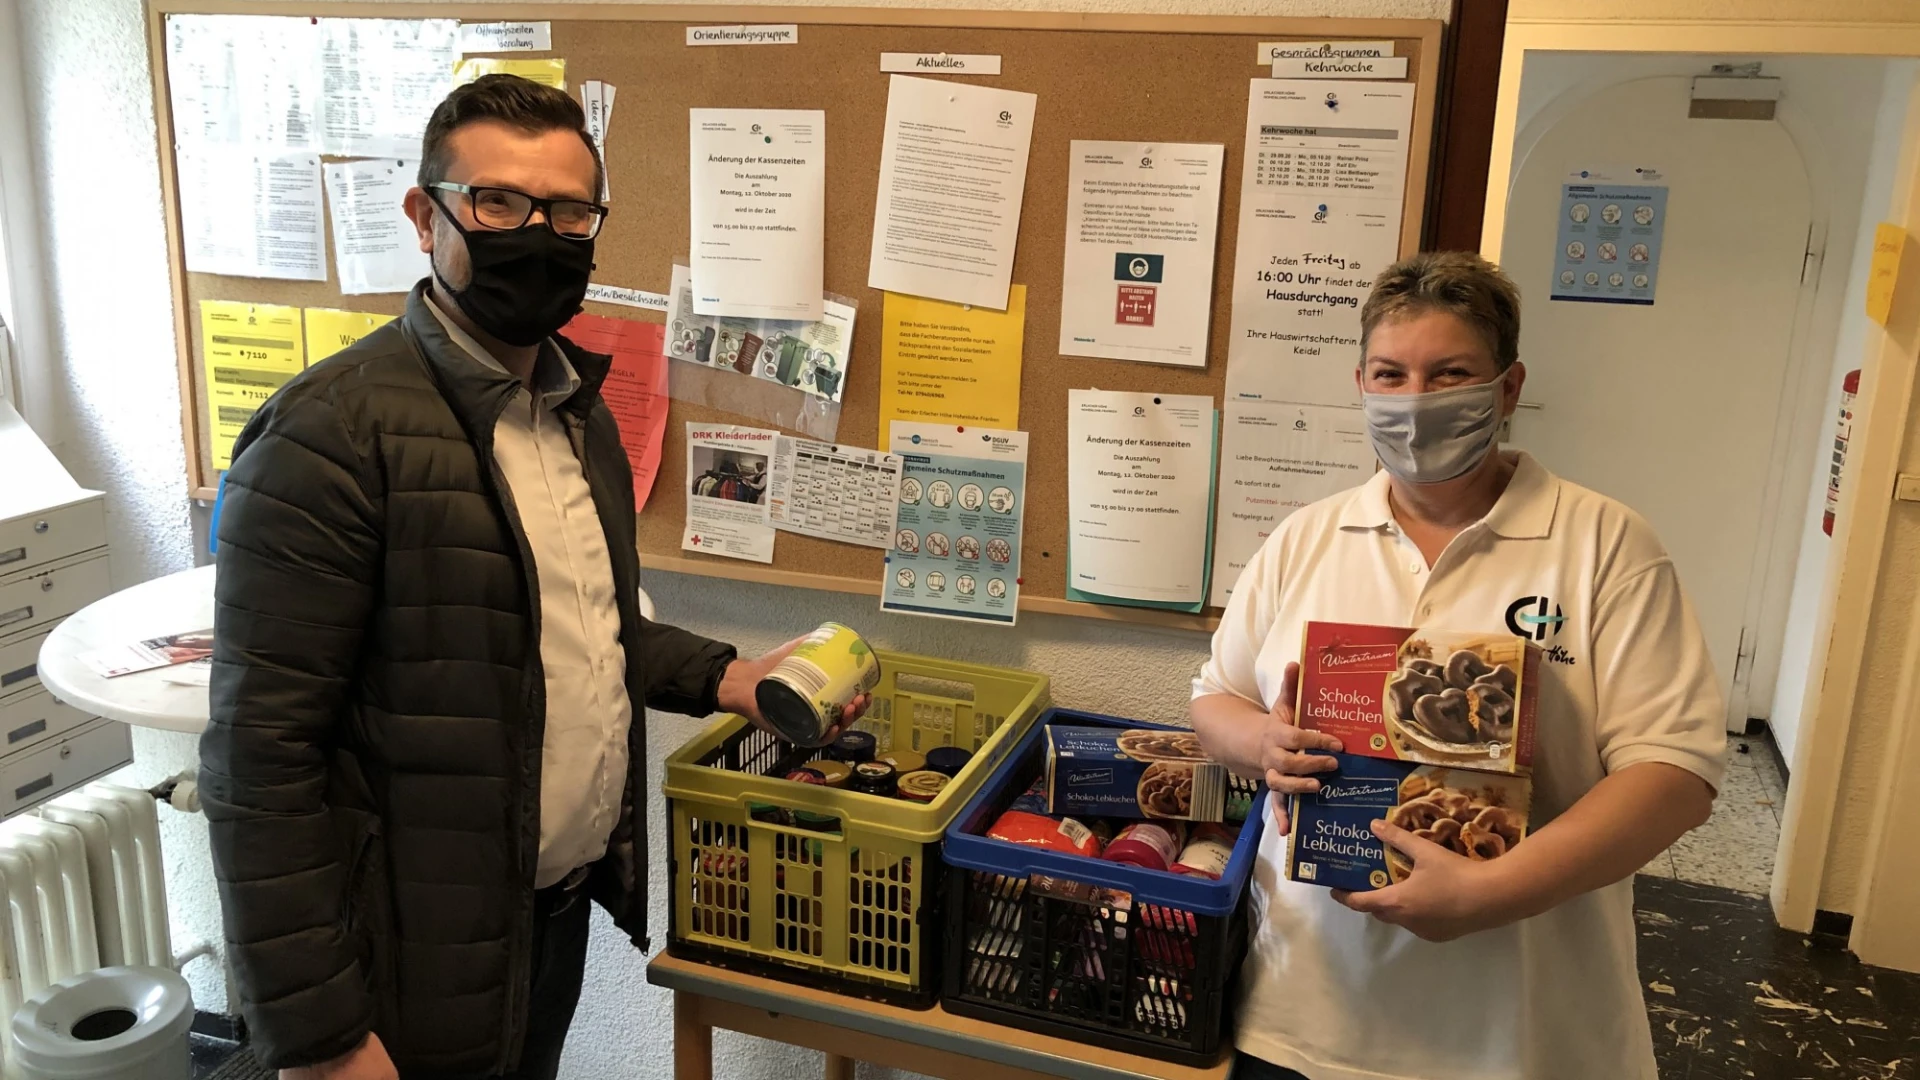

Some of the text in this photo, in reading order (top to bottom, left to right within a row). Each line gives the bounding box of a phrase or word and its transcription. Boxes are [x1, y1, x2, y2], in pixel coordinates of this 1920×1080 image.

[693, 29, 790, 42] Orientierungsgruppe
[916, 57, 965, 68] Aktuelles
[1305, 62, 1374, 72] Kehrwoche
[591, 100, 599, 122] Idee
[1261, 127, 1304, 135] Kehrwoche
[708, 154, 806, 165] Änderung der Kassenzeiten
[745, 173, 778, 181] Auszahlung
[1137, 182, 1189, 190] Fachberatungsstelle
[720, 189, 744, 197] Montag,
[1106, 188, 1160, 197] Hygienemaßnahmen
[1270, 253, 1361, 270] Jeden Freitag ab
[1257, 271, 1372, 288] 16:00 Uhr findet der
[586, 287, 669, 307] egeln/Besuchszeite
[1266, 289, 1358, 308] Hausdurchgang
[1298, 308, 1324, 317] statt!
[939, 324, 971, 333] Verständnis,
[920, 333, 972, 343] Fachberatungsstelle
[1247, 329, 1357, 345] Ihre Hauswirtschafterin
[899, 341, 931, 349] Rücksprache
[952, 346, 992, 354] Sozialarbeitern
[1293, 346, 1321, 356] Keidel
[917, 353, 939, 361] gewährt
[692, 431, 773, 441] DRK Kleiderladen
[1086, 435, 1191, 448] Änderung der Kassenzeiten
[1124, 455, 1161, 463] Auszahlung
[1253, 456, 1302, 465] Bewohnerinnen
[1315, 461, 1347, 469] Bewohner
[903, 464, 1005, 480] lgemeine Schutzmaßnahmen
[1097, 470, 1122, 479] Montag,
[1134, 472, 1160, 480] Oktober
[1269, 465, 1326, 476] Aufnahmehauses!
[1232, 512, 1262, 522] festgelegt
[1322, 652, 1394, 667] Wintertraum
[1319, 687, 1376, 706] Schoko-
[1307, 702, 1383, 724] Lebkuchen
[1059, 744, 1120, 752] Lebkuchen
[1320, 785, 1396, 799] Wintertraum
[1067, 792, 1136, 804] Schoko-Lebkuchen
[1315, 819, 1375, 841] Schoko-
[1302, 834, 1383, 860] Lebkuchen
